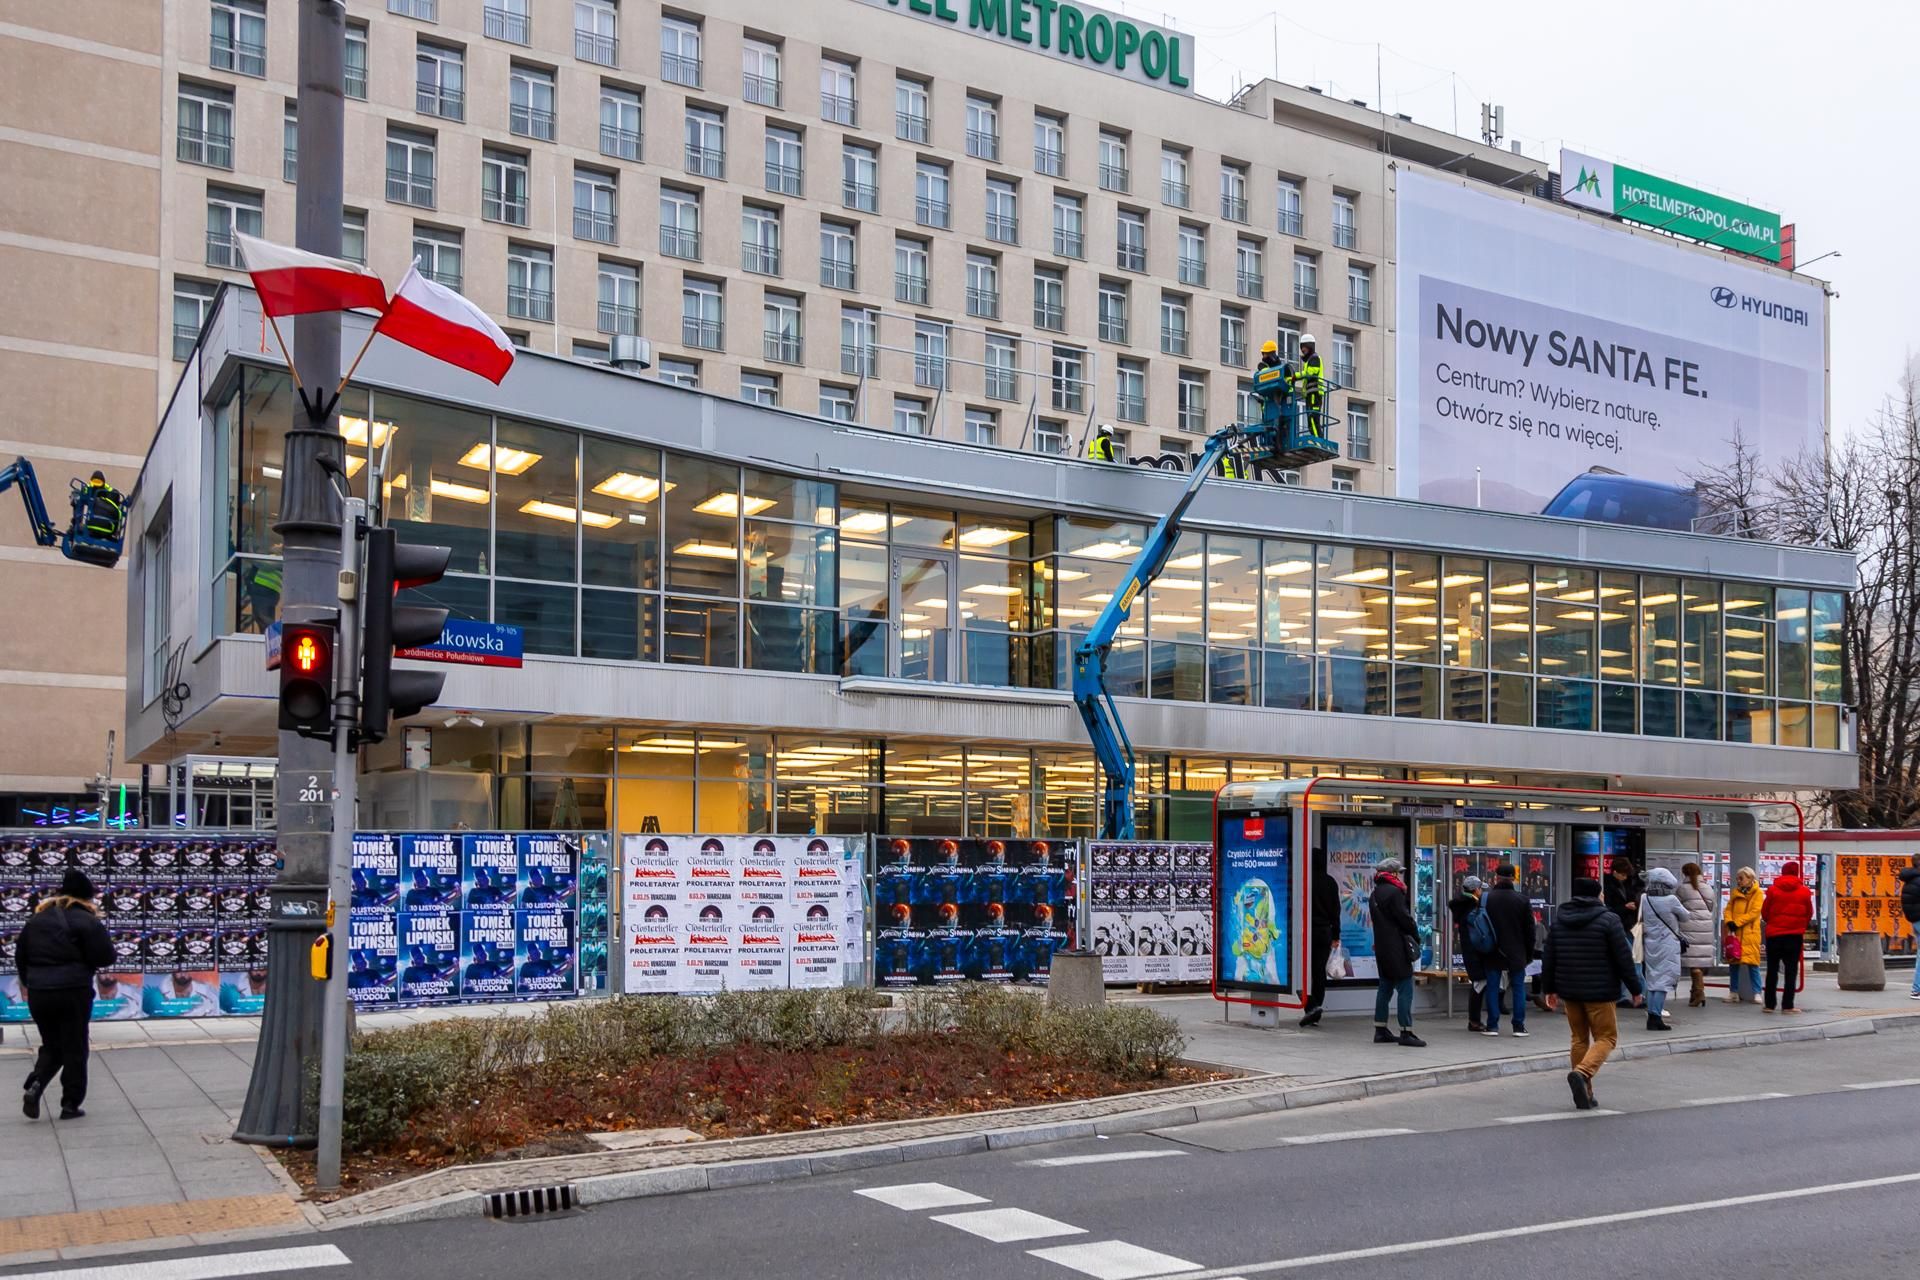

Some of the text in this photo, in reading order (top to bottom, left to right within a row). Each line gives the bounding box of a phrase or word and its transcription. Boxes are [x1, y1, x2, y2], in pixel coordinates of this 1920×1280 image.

[969, 0, 1189, 88] METROPOL
[1622, 183, 1777, 244] HOTELMETROPOL.COM.PL
[1741, 295, 1808, 327] HYUNDAI
[1437, 303, 1708, 398] Nowy SANTA FE.
[1436, 363, 1661, 431] Centrum? Wybierz naturę.
[1436, 396, 1622, 454] Otwórz się na więcej.
[446, 652, 485, 663] Południowe
[308, 775, 318, 788] 2
[299, 789, 324, 802] 201
[352, 841, 394, 855] TOMEK
[414, 841, 454, 854] TOMEK
[475, 841, 514, 854] TOMEK
[529, 841, 567, 853] TOMEK
[1245, 860, 1257, 868] 500
[410, 917, 450, 931] TOMEK
[473, 916, 512, 929] TOMEK
[527, 915, 564, 927] TOMEK
[352, 922, 394, 935] TOMEK
